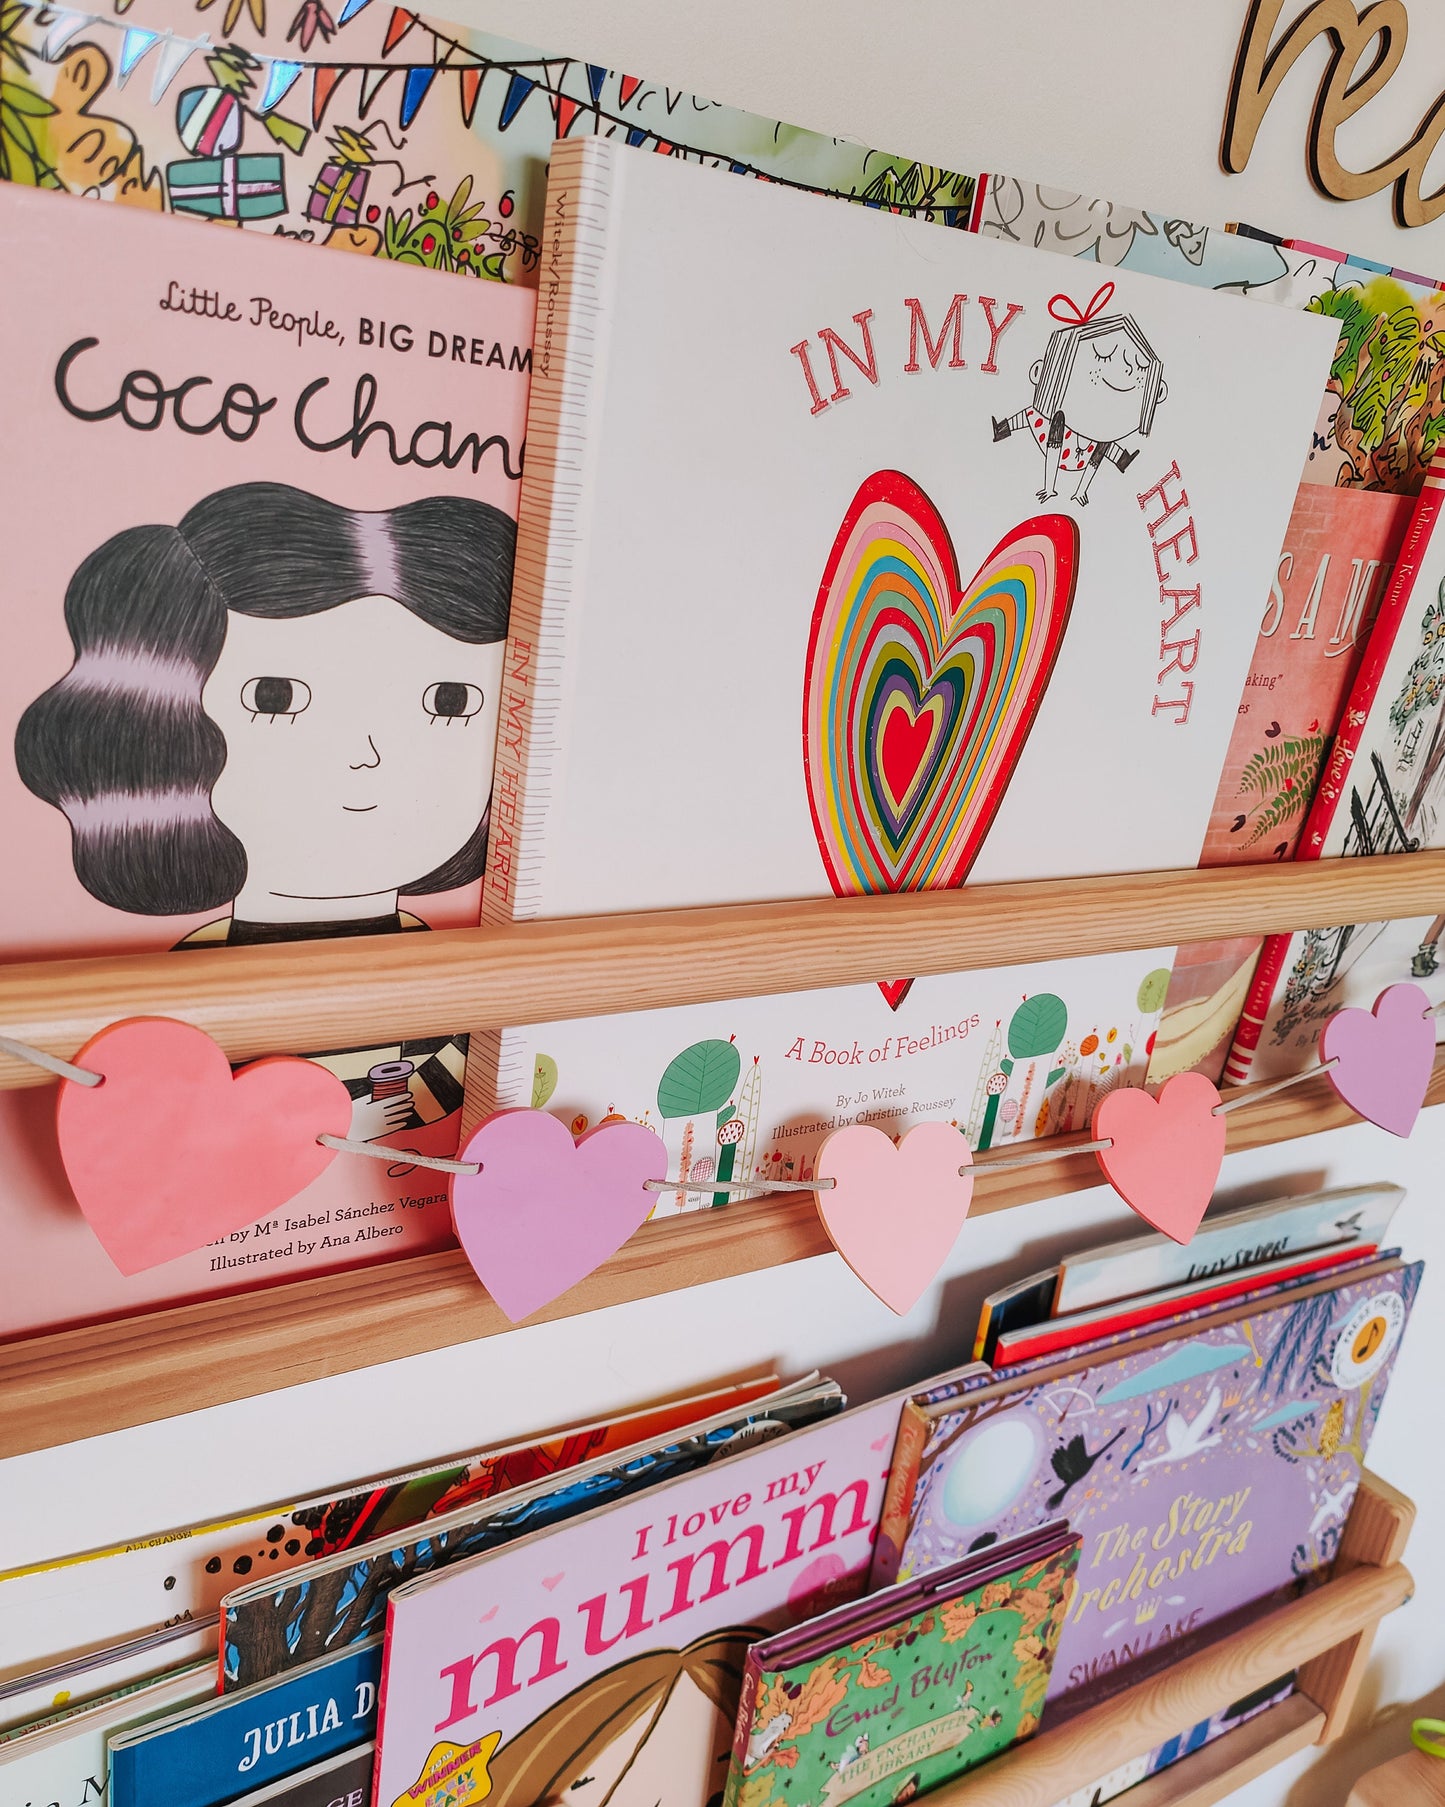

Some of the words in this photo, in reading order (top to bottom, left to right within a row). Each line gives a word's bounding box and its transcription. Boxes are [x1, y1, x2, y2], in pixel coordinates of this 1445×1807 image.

[539, 191, 567, 378] Witek/Roussey
[160, 281, 242, 321] Little
[250, 297, 345, 347] People,
[358, 317, 414, 352] BIG
[55, 336, 277, 442] Coco
[295, 373, 526, 480] Chan
[790, 308, 881, 416] IN
[904, 293, 1024, 374] MY
[1136, 460, 1202, 725] HEART
[1409, 501, 1434, 551] Adams
[1391, 562, 1414, 606] Keane
[511, 637, 532, 686] IN
[505, 692, 526, 762] MY
[1331, 737, 1355, 782] Love
[1322, 782, 1340, 805] is
[491, 767, 519, 902] HEART
[785, 1037, 805, 1060] A
[808, 1041, 864, 1065] Book
[869, 1037, 892, 1063] of
[895, 1013, 980, 1058] Feelings
[771, 1114, 836, 1140] Illustrated
[838, 1111, 854, 1127] by
[855, 1103, 909, 1124] Christine
[911, 1096, 956, 1114] Roussey
[835, 1095, 852, 1108] By
[854, 1092, 868, 1104] Jo
[872, 1083, 906, 1100] Witek
[285, 1211, 330, 1231] Isabel
[335, 1200, 395, 1221] Sánchez
[399, 1191, 448, 1210] Vegara
[209, 1244, 293, 1271] Illustrated
[297, 1240, 317, 1255] by
[320, 1236, 350, 1249] Ana
[355, 1224, 403, 1242] Albero
[631, 1525, 653, 1561] I
[662, 1492, 751, 1548] love
[762, 1460, 826, 1503] my
[1090, 1523, 1148, 1568] The
[1152, 1487, 1252, 1551] Story
[125, 1543, 147, 1553] ALL
[149, 1531, 193, 1548] CHANGE!
[434, 1471, 889, 1733] mumm
[825, 1684, 903, 1737] Enid
[911, 1644, 993, 1698] Blyton
[238, 1697, 343, 1772] JULIA
[408, 1742, 482, 1799] WINNER
